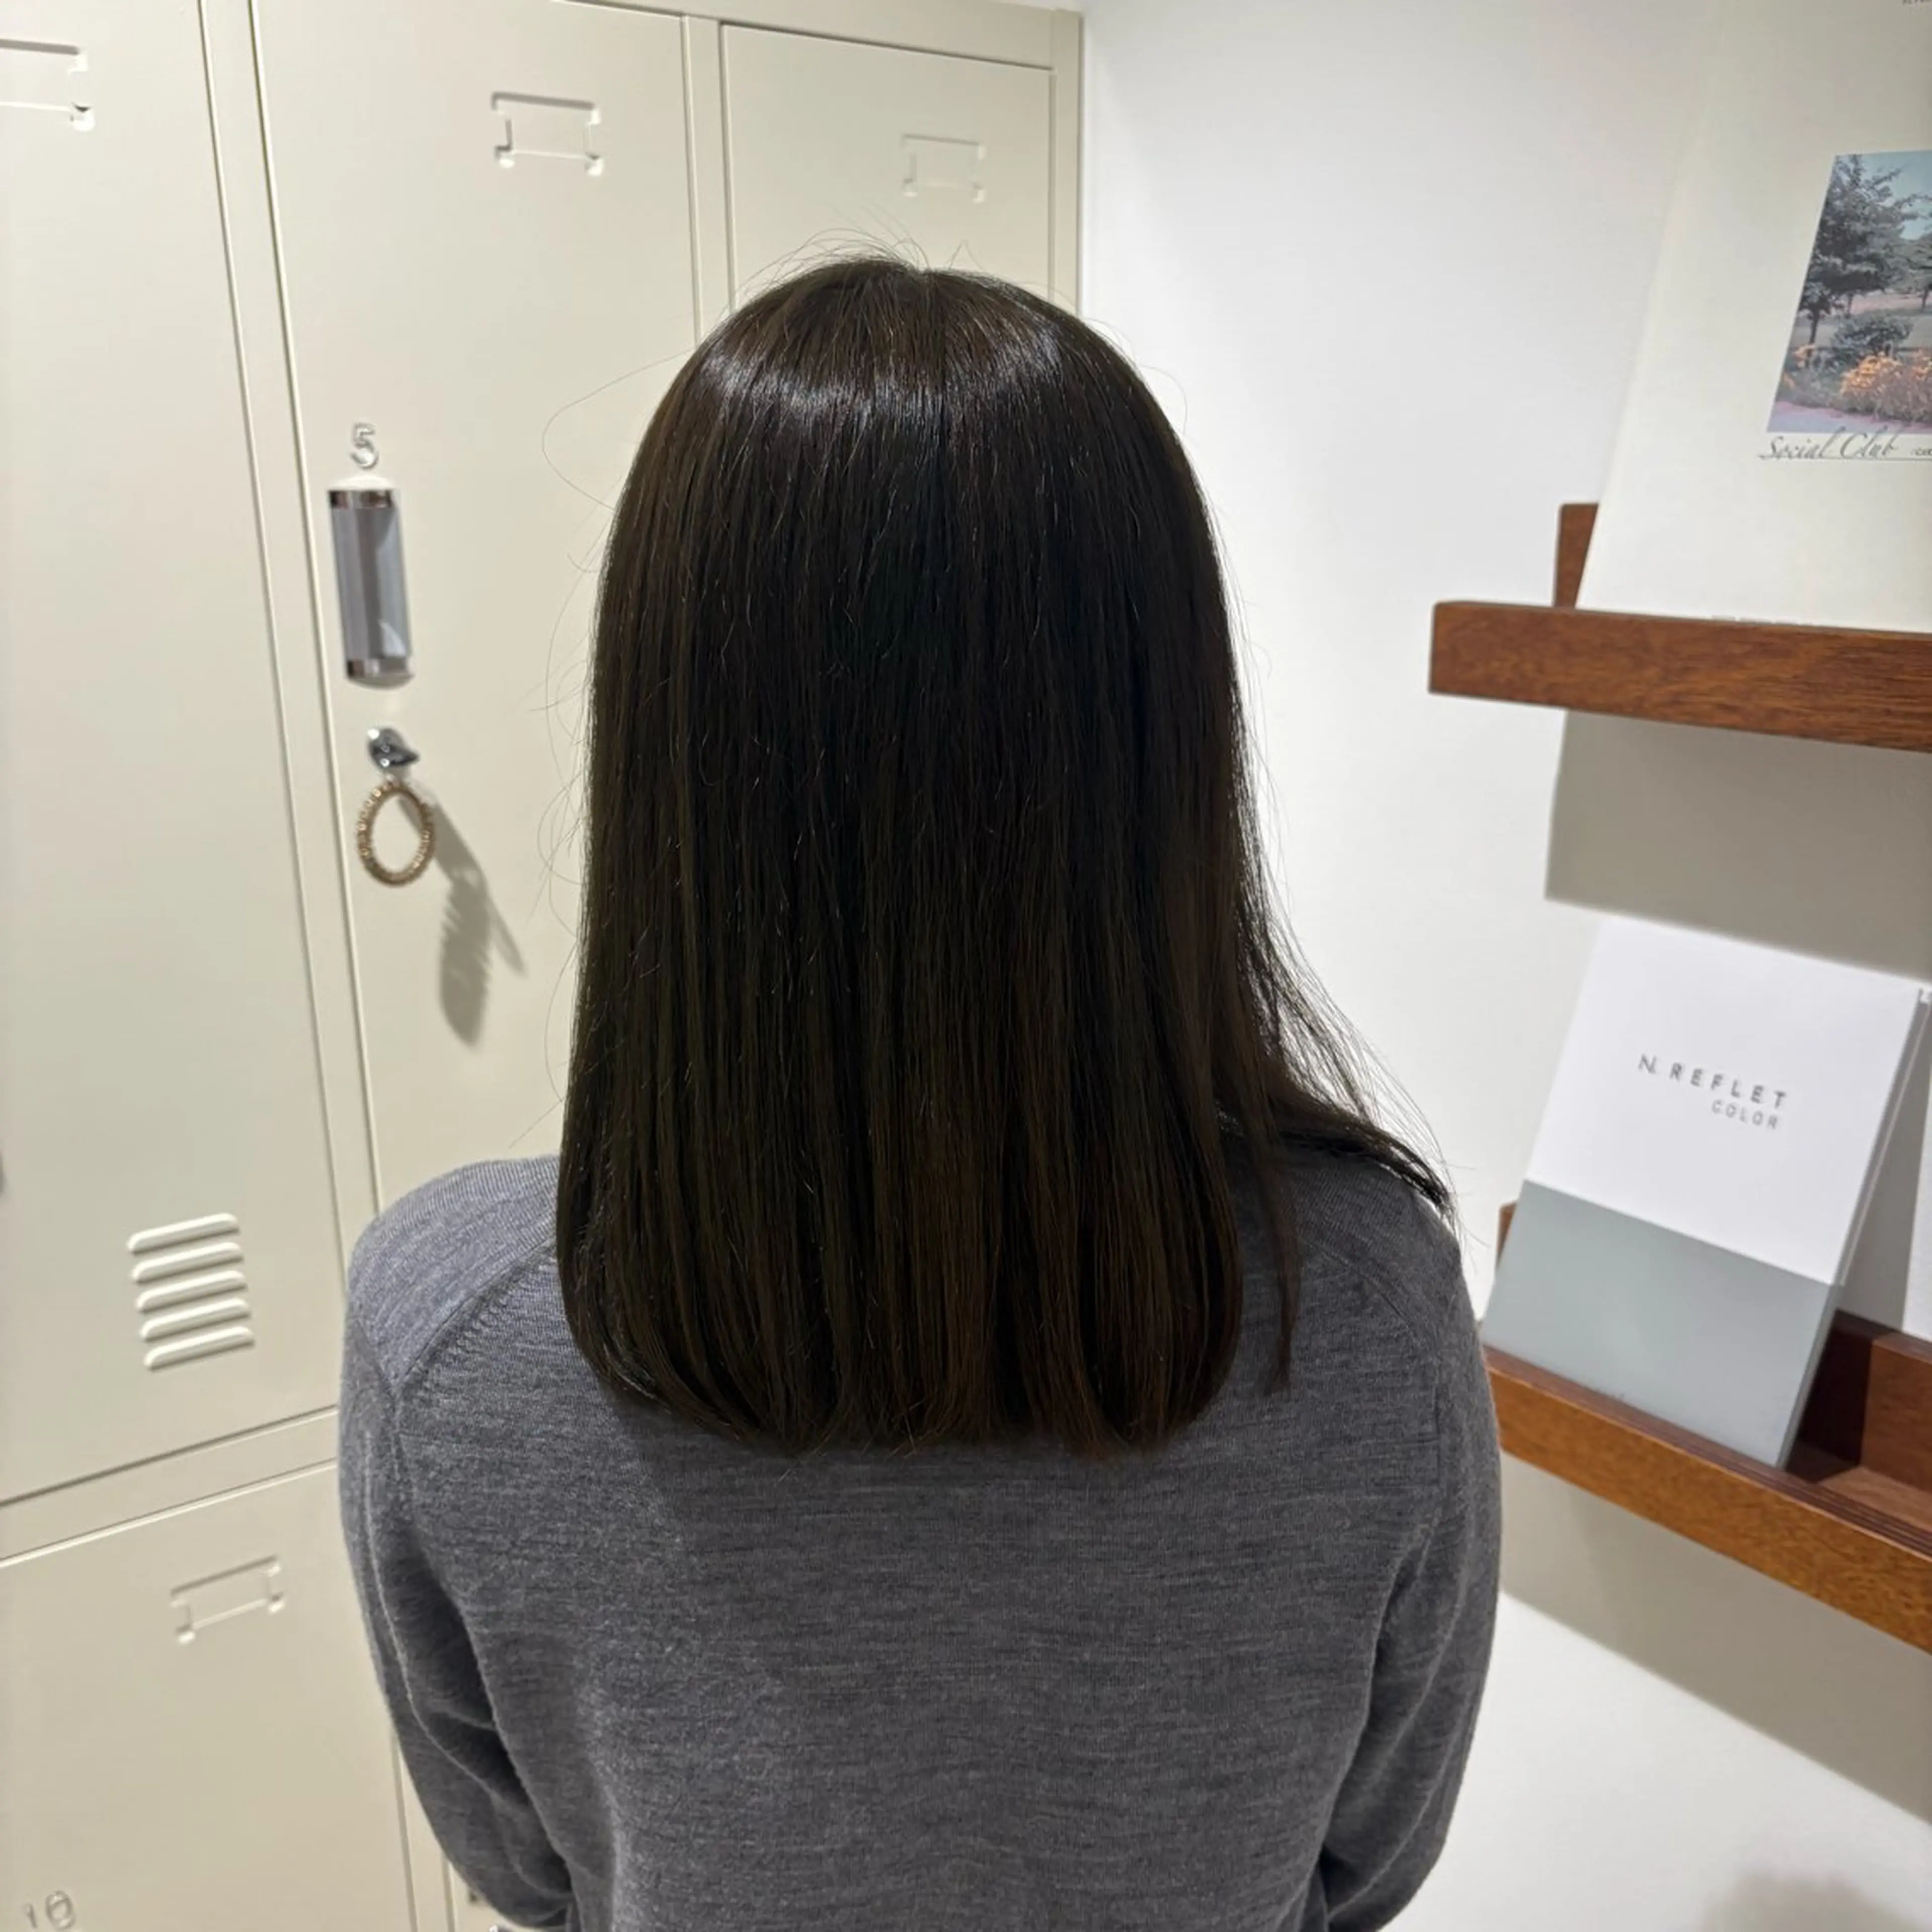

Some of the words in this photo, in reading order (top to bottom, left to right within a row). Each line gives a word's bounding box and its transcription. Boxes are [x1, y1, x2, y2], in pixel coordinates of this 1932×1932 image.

[351, 422, 379, 470] 5
[1760, 426, 1845, 460] Social
[1840, 425, 1900, 459] Club
[1669, 1062, 1787, 1109] REFLET
[1712, 1099, 1779, 1130] COLOR
[22, 1889, 76, 1931] 10
